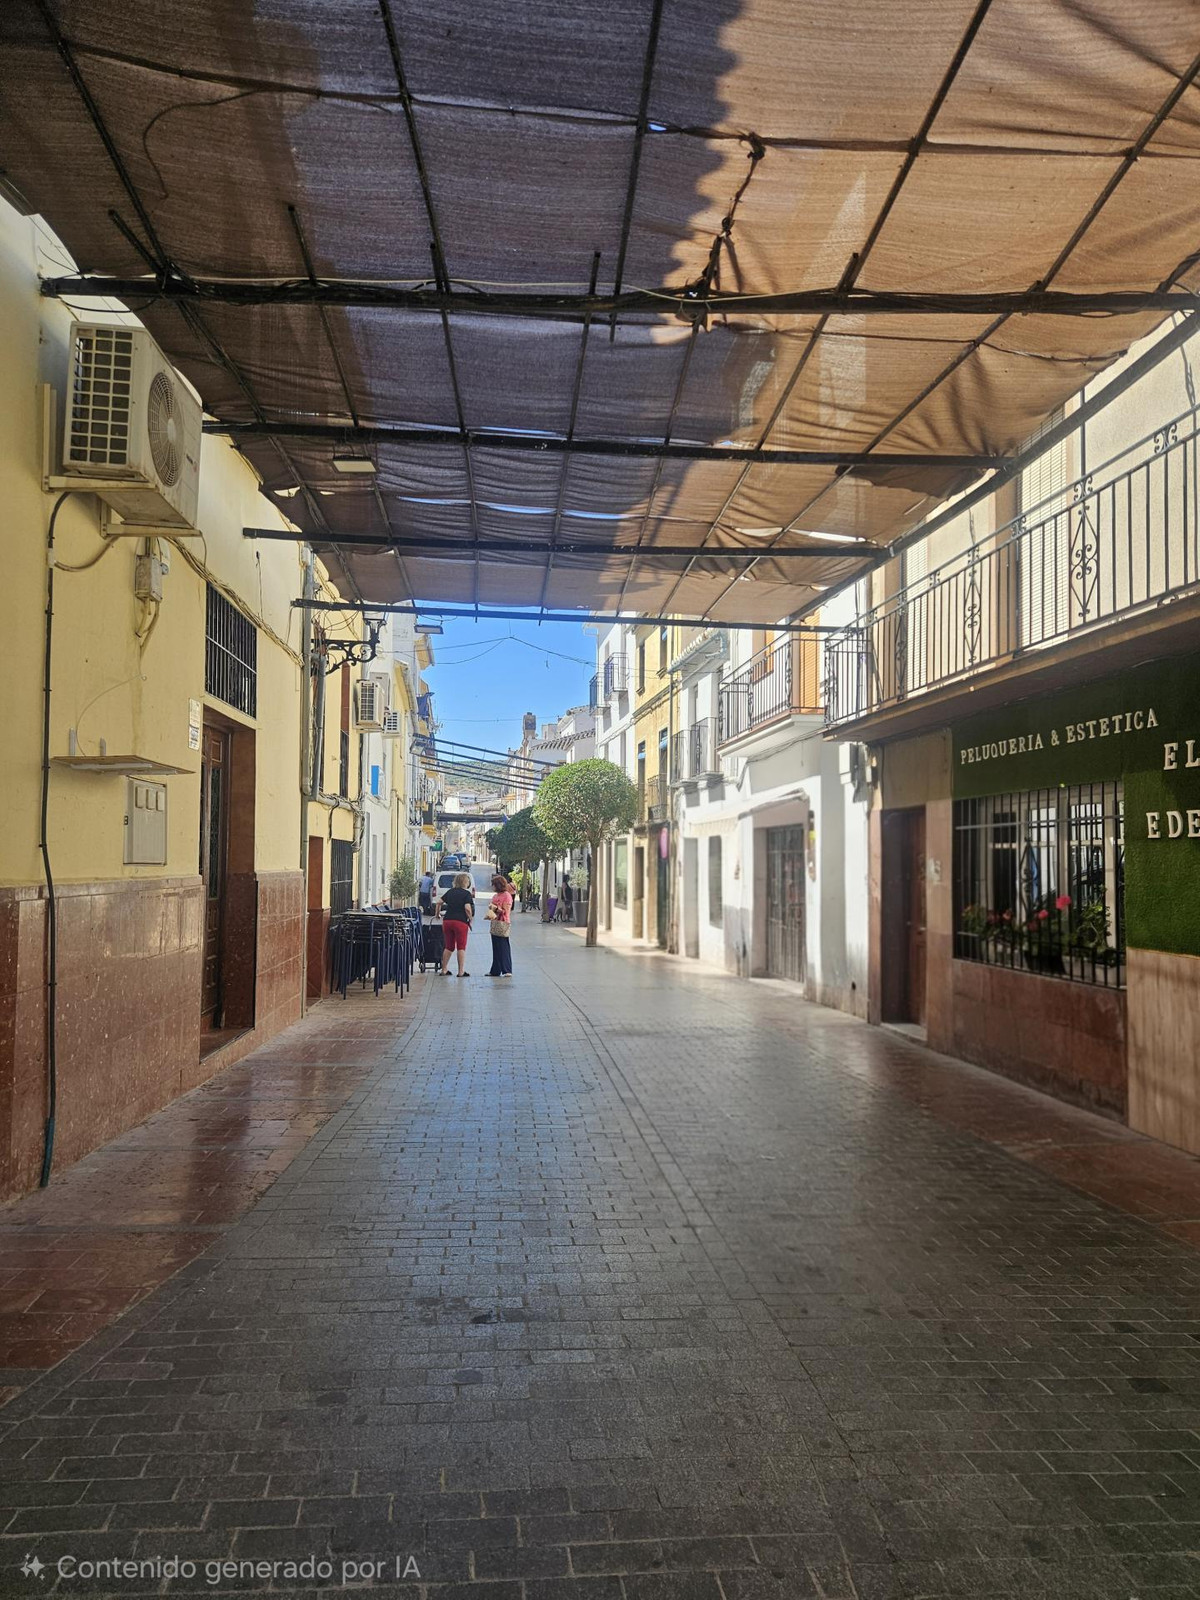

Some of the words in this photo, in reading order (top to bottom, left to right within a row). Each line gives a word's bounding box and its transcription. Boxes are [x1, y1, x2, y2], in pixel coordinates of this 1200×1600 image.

[960, 733, 1044, 765] PELUQUERIA
[1051, 729, 1060, 746] &
[1066, 708, 1159, 744] ESTETICA
[1163, 740, 1200, 770] EL
